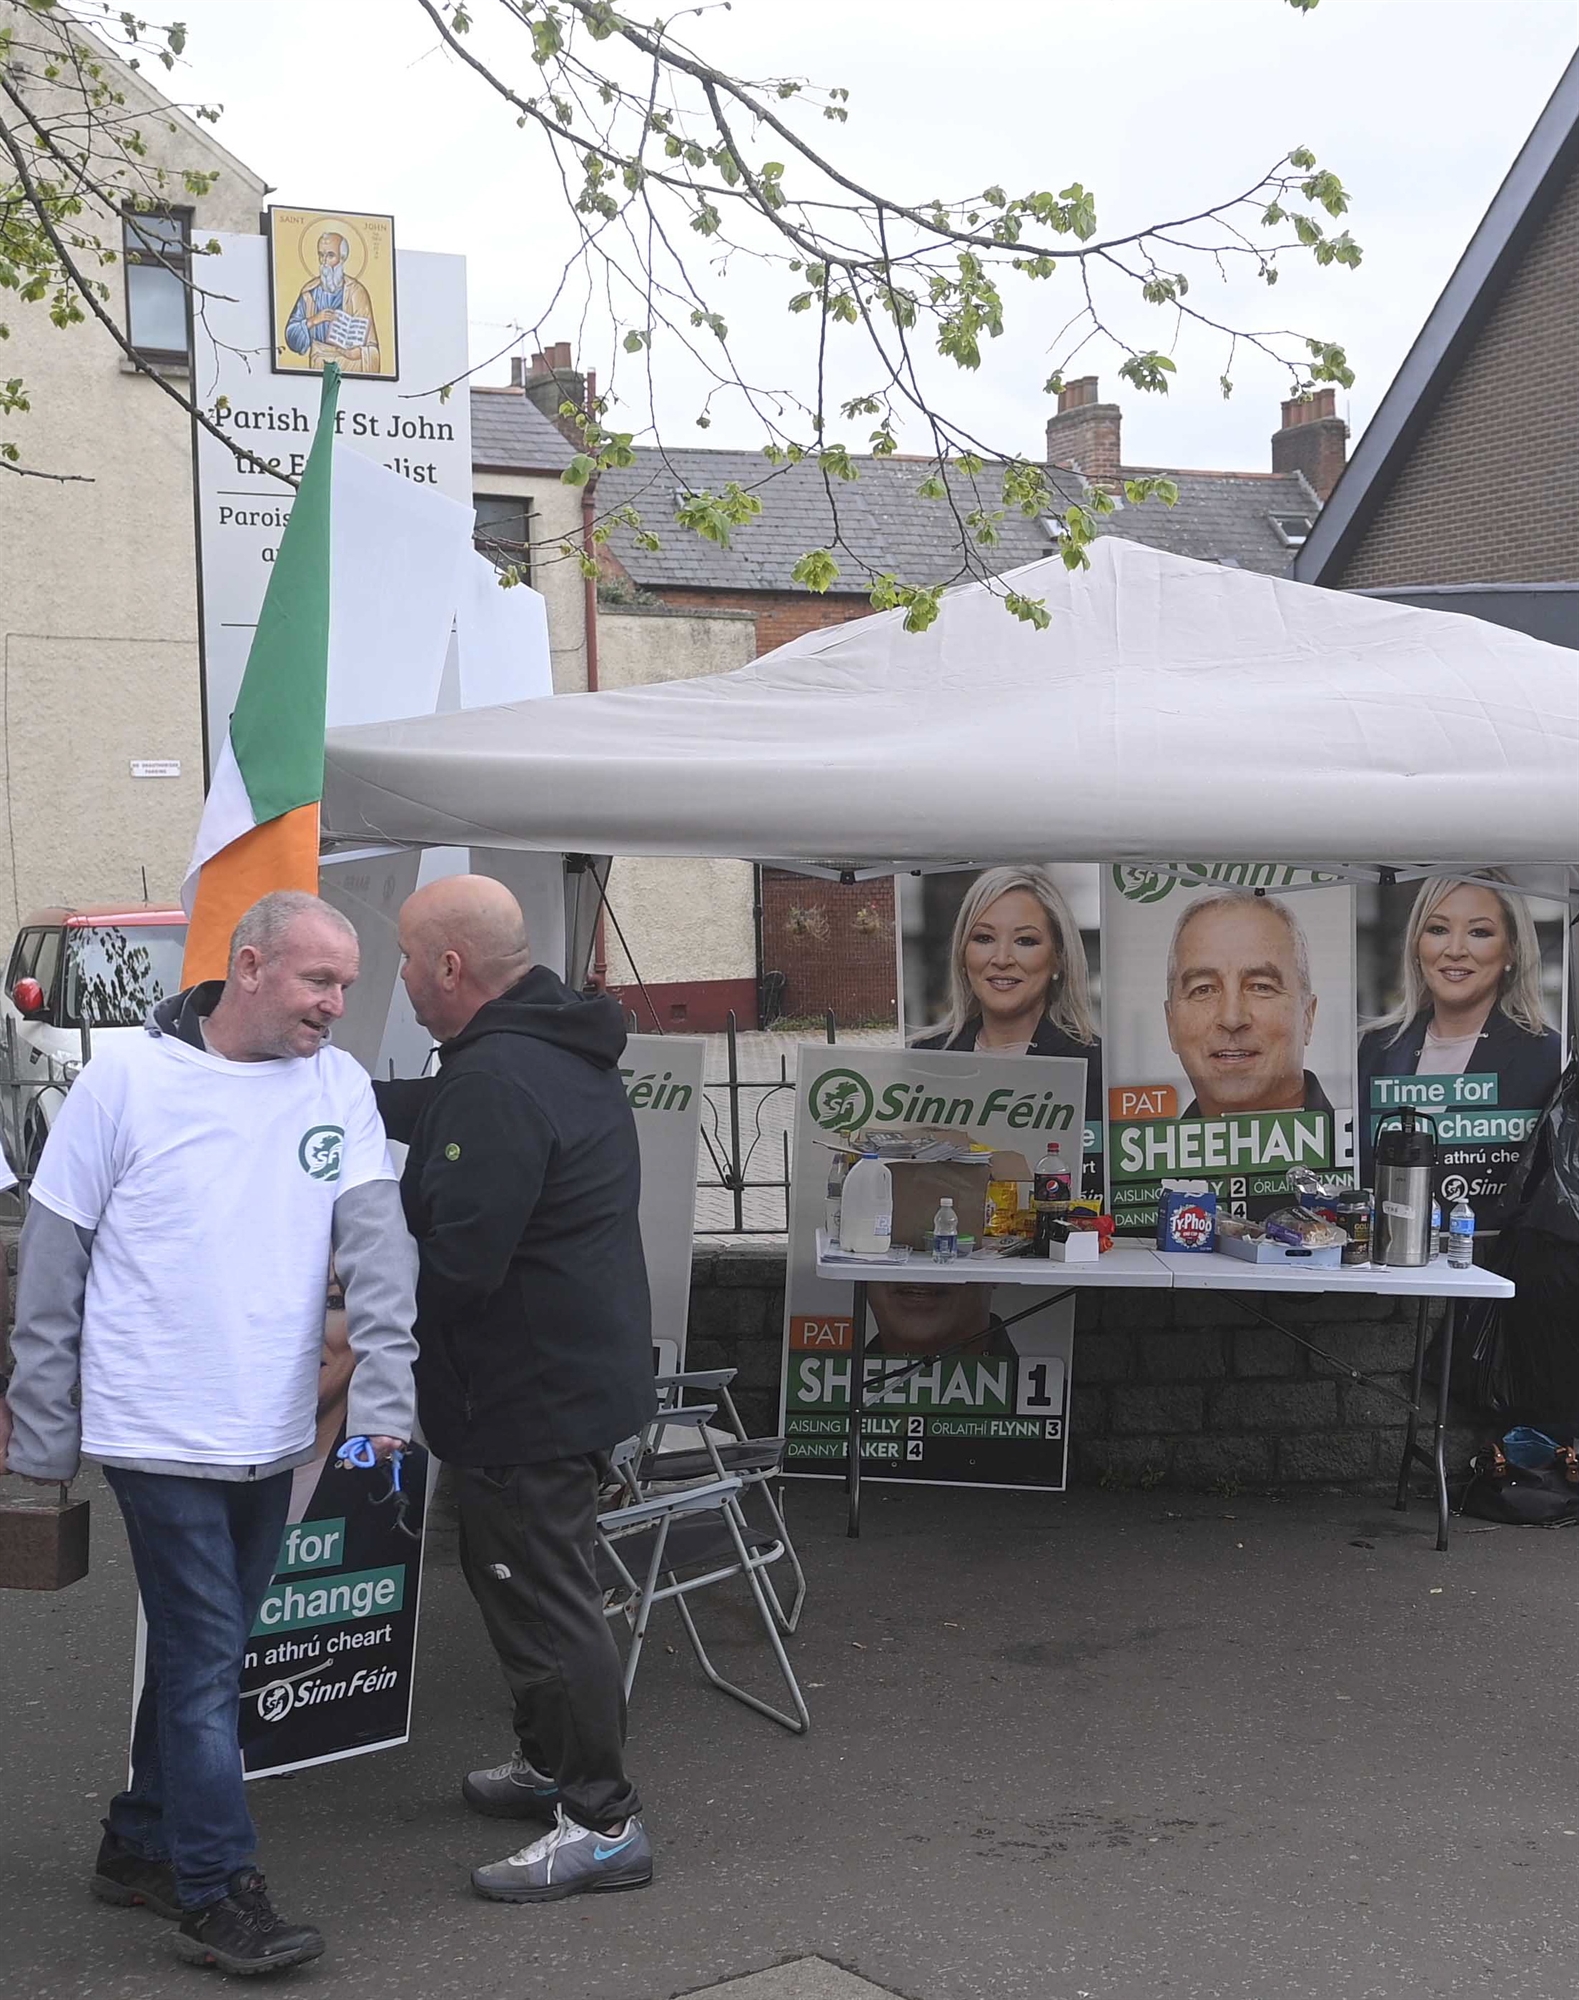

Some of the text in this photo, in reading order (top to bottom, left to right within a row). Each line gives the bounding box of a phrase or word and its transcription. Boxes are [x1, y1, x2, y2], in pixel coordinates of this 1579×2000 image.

[279, 216, 387, 231] SAINT JOHN
[214, 406, 455, 441] Parish f St John
[219, 506, 291, 527] Parois
[1121, 1090, 1167, 1116] PAT
[1374, 1077, 1495, 1103] Time for
[875, 1083, 1075, 1131] Sinn Féin
[1438, 1114, 1539, 1142] change
[1119, 1115, 1325, 1173] SHEEHAN
[1444, 1148, 1520, 1165] athrú che
[1232, 1180, 1244, 1195] 2
[1233, 1203, 1246, 1219] 4
[803, 1322, 850, 1345] PAT
[797, 1357, 1051, 1406] SHEEHAN 1
[788, 1420, 841, 1433] AISLING
[910, 1419, 922, 1434] 2
[932, 1419, 1060, 1438] ÓRLAITHÍ FLYNN 3
[788, 1444, 838, 1456] DANNY
[909, 1443, 921, 1458] 4
[286, 1528, 340, 1565] for
[260, 1577, 396, 1625] change
[264, 1634, 320, 1665] athrú
[326, 1623, 392, 1654] cheart
[293, 1665, 398, 1708] Sinn Féin
